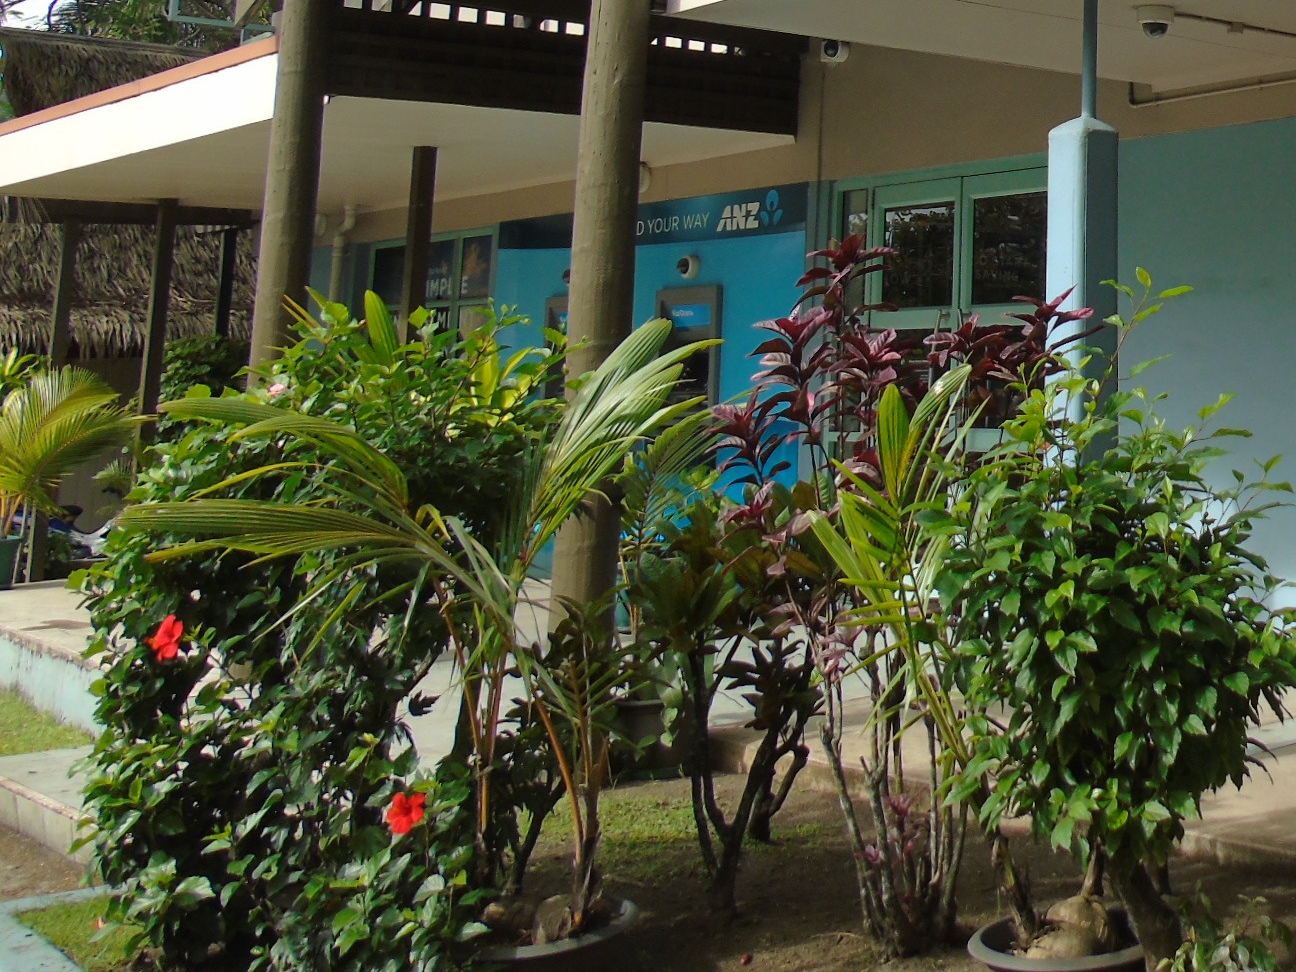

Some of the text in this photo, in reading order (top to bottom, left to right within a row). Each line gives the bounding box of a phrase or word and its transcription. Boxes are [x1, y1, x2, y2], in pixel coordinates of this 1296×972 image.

[647, 215, 680, 234] YOUR
[683, 212, 711, 230] WAY
[716, 202, 760, 232] ANZ
